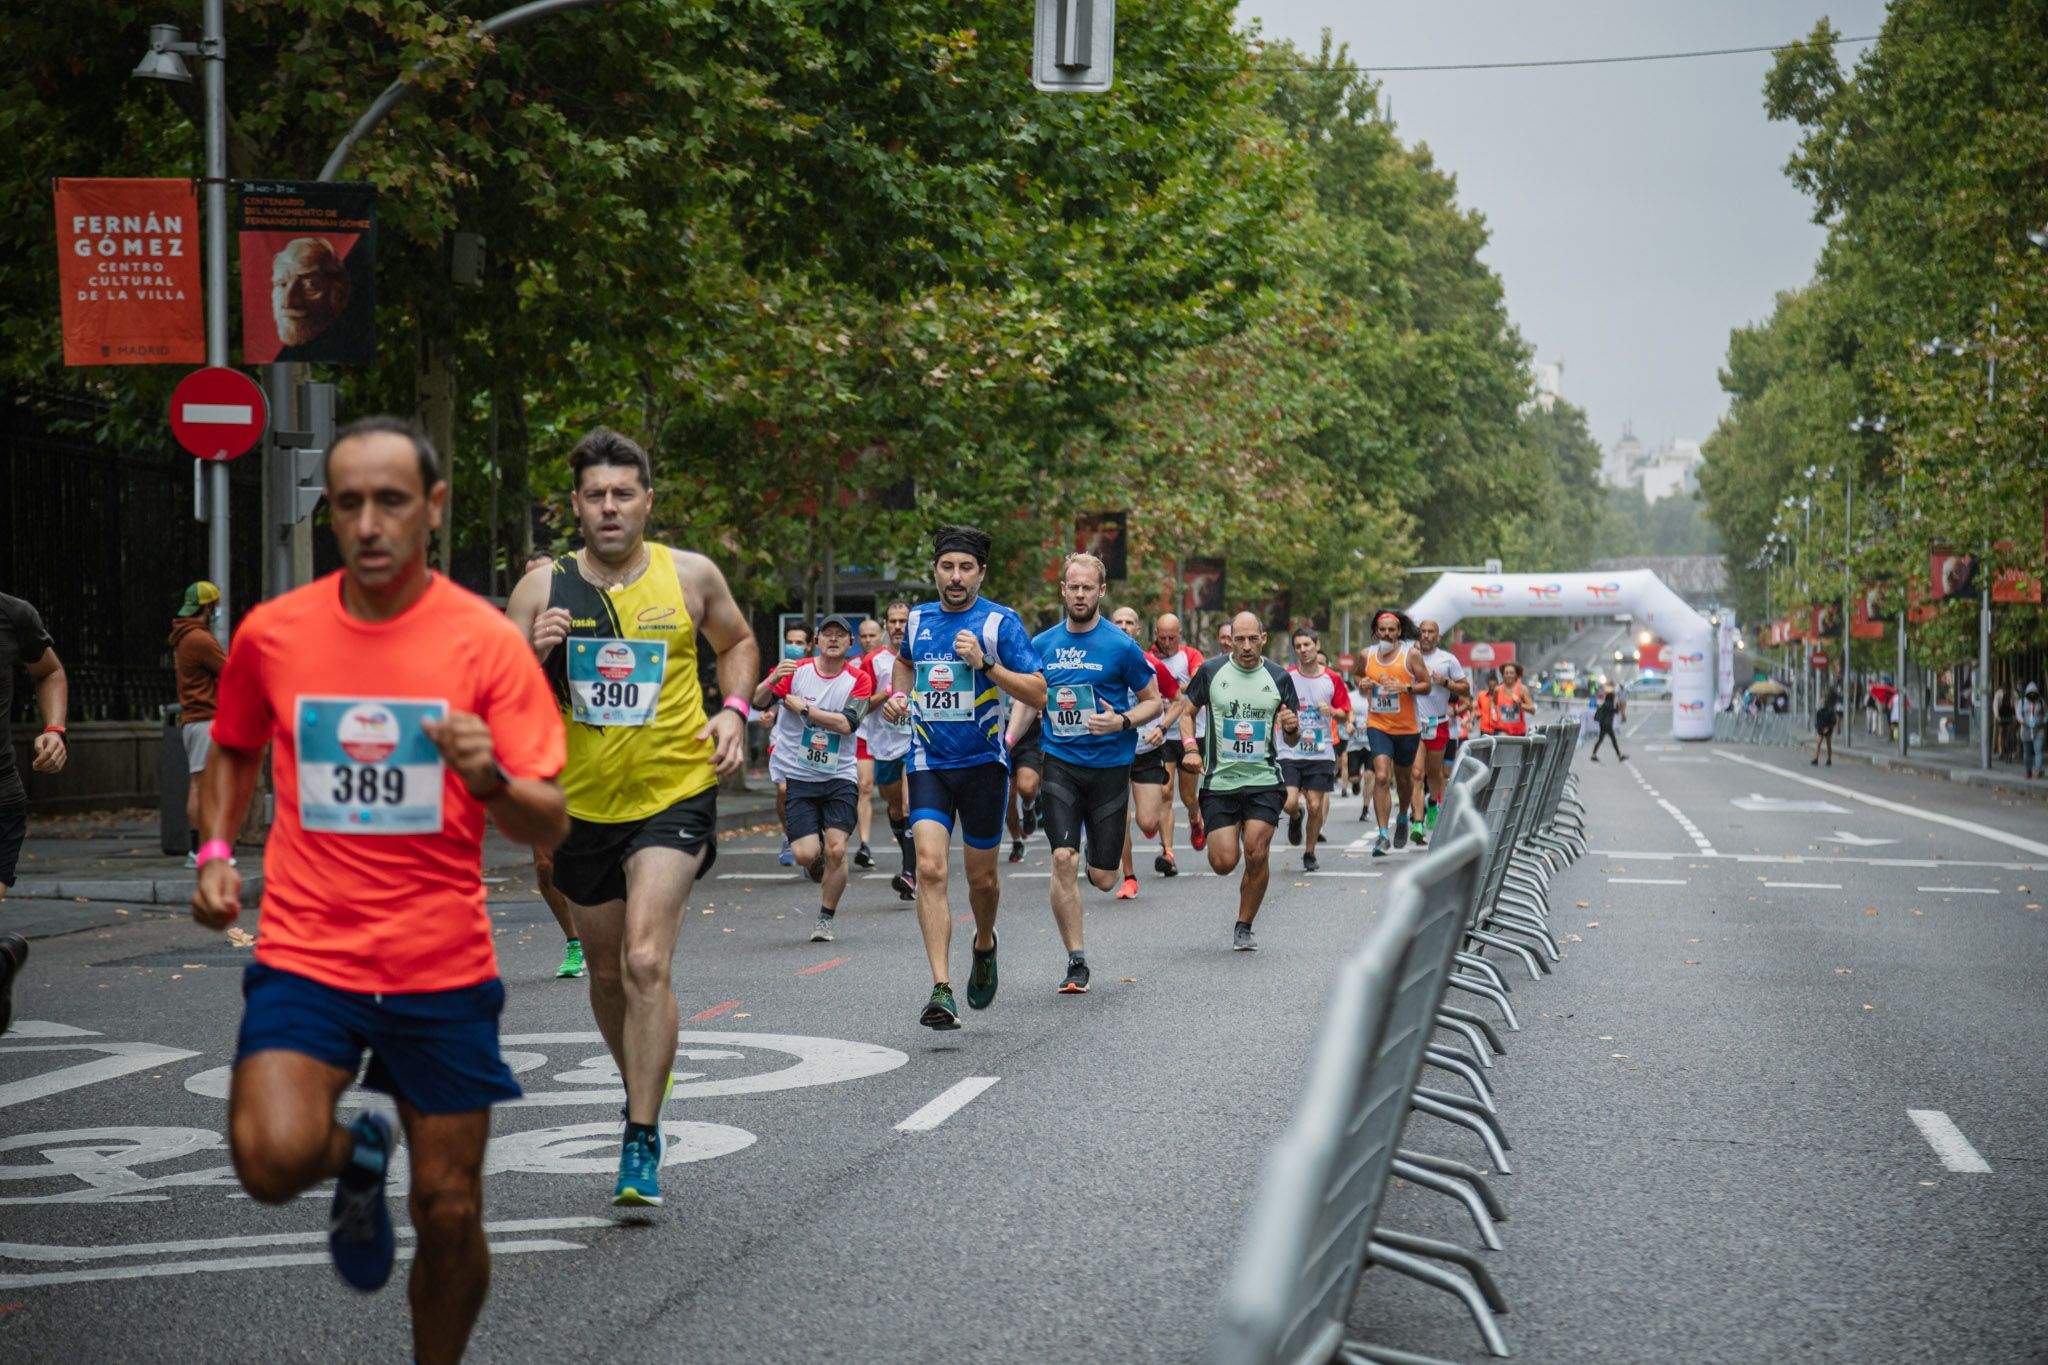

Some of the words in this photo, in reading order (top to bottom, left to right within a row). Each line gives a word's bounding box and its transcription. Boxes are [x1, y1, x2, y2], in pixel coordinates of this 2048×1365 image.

[73, 211, 182, 234] FERNÁN
[74, 234, 183, 256] GÓMEZ
[98, 262, 164, 272] CENTRO
[88, 276, 174, 287] CULTURAL
[78, 291, 98, 301] DE
[107, 290, 128, 300] LA
[137, 290, 185, 300] VILLA
[924, 652, 953, 661] CLUB
[591, 682, 639, 708] 390
[924, 691, 960, 709] 1231
[1057, 710, 1082, 726] 402
[1233, 741, 1254, 753] 415
[806, 748, 829, 763] 385
[332, 764, 405, 805] 389
